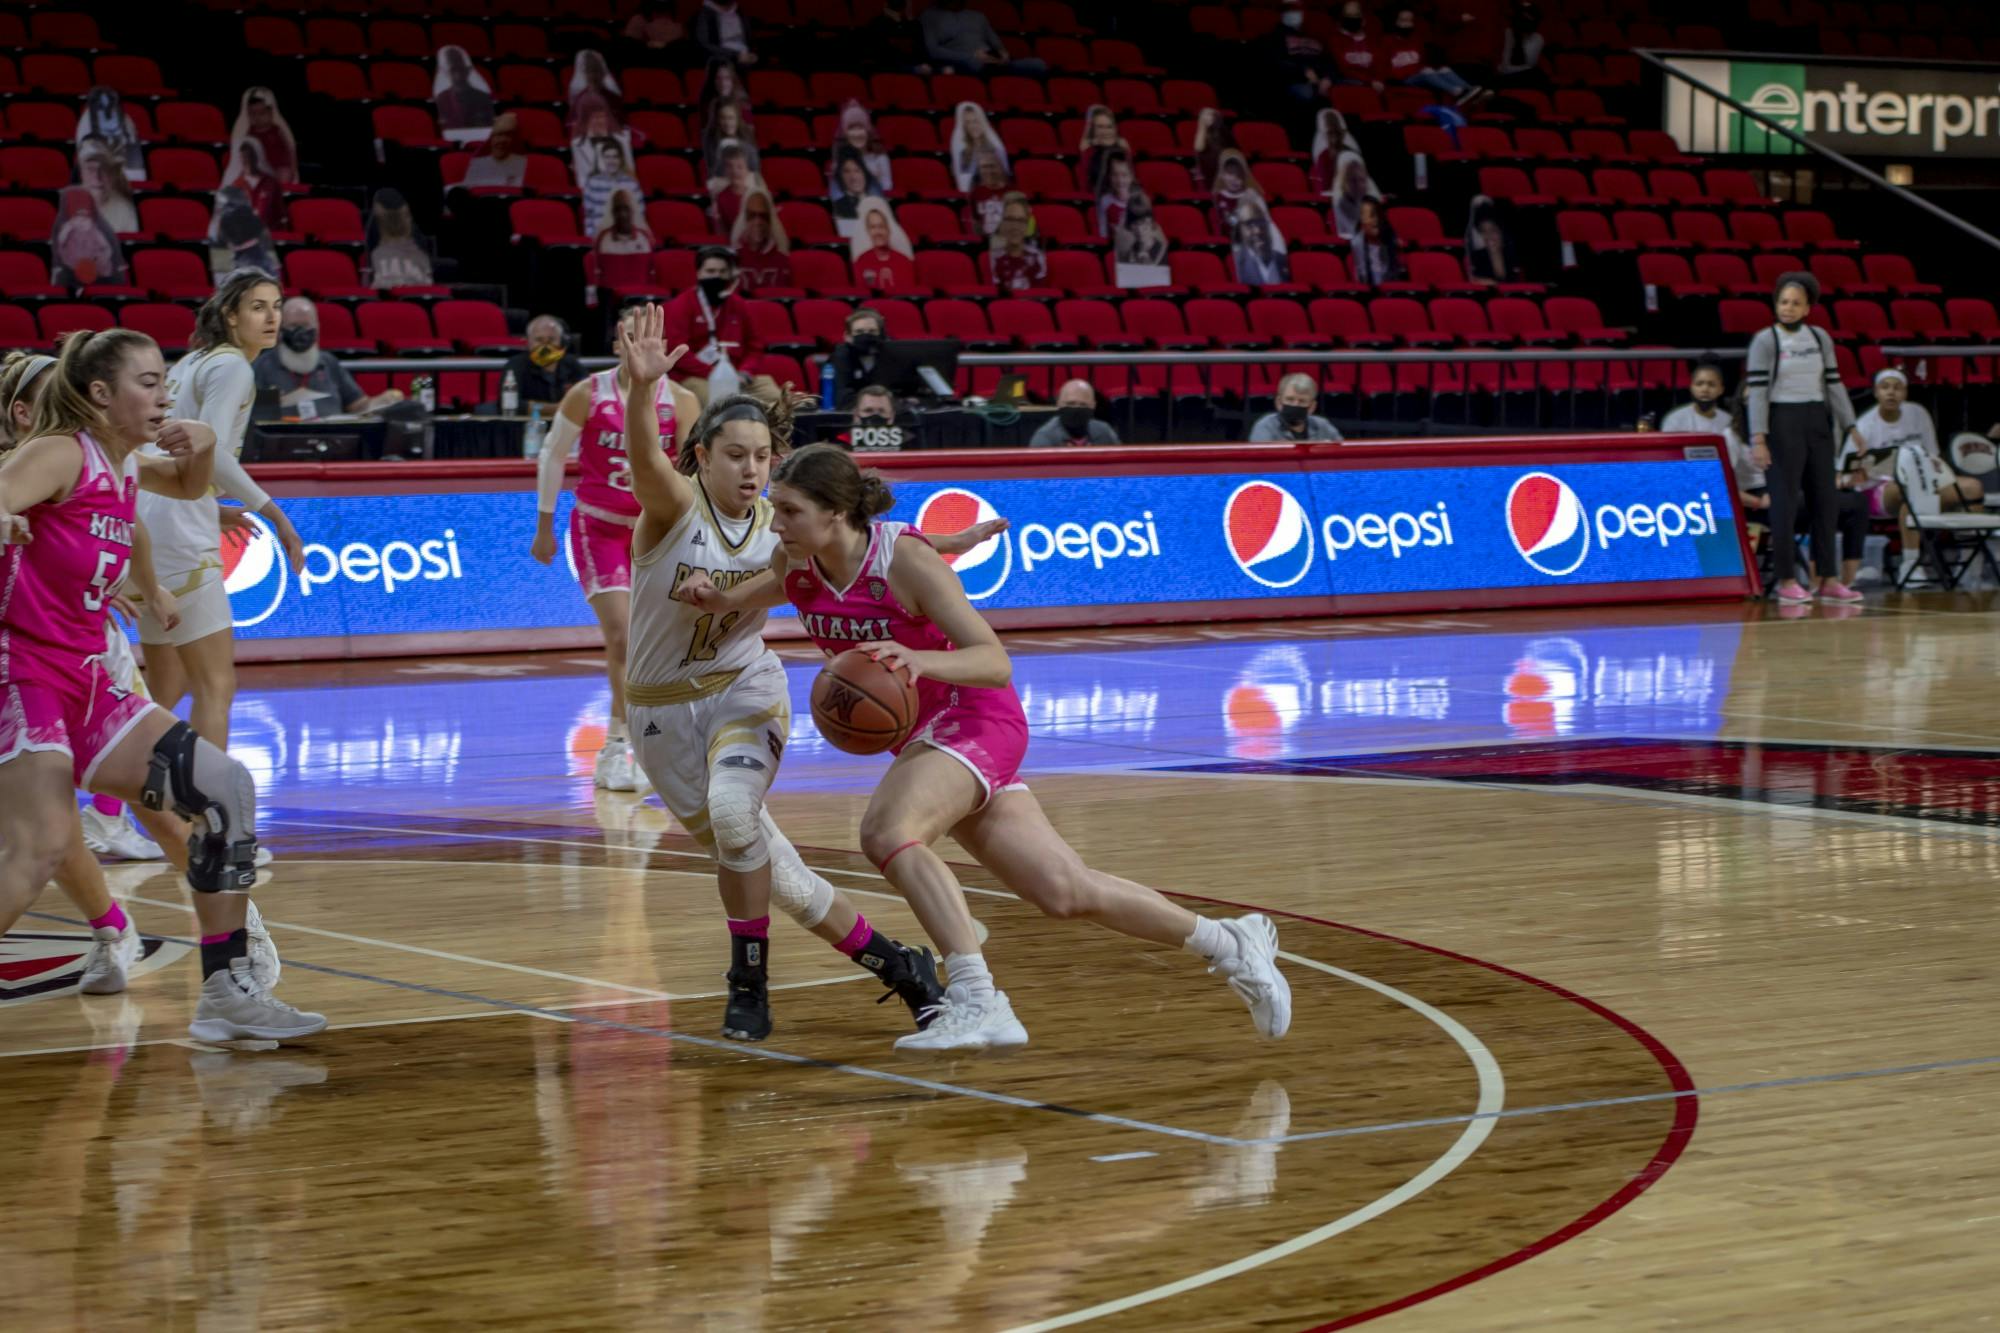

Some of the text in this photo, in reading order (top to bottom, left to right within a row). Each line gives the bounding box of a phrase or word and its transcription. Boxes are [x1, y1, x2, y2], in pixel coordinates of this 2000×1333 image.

[1736, 81, 2000, 151] enterpr
[851, 427, 903, 446] POSS
[1019, 510, 1161, 572] pepsi
[1322, 501, 1454, 561] pepsi
[1595, 492, 1717, 549] pepsi
[299, 528, 463, 596] pepsi
[798, 609, 893, 641] MIAMI
